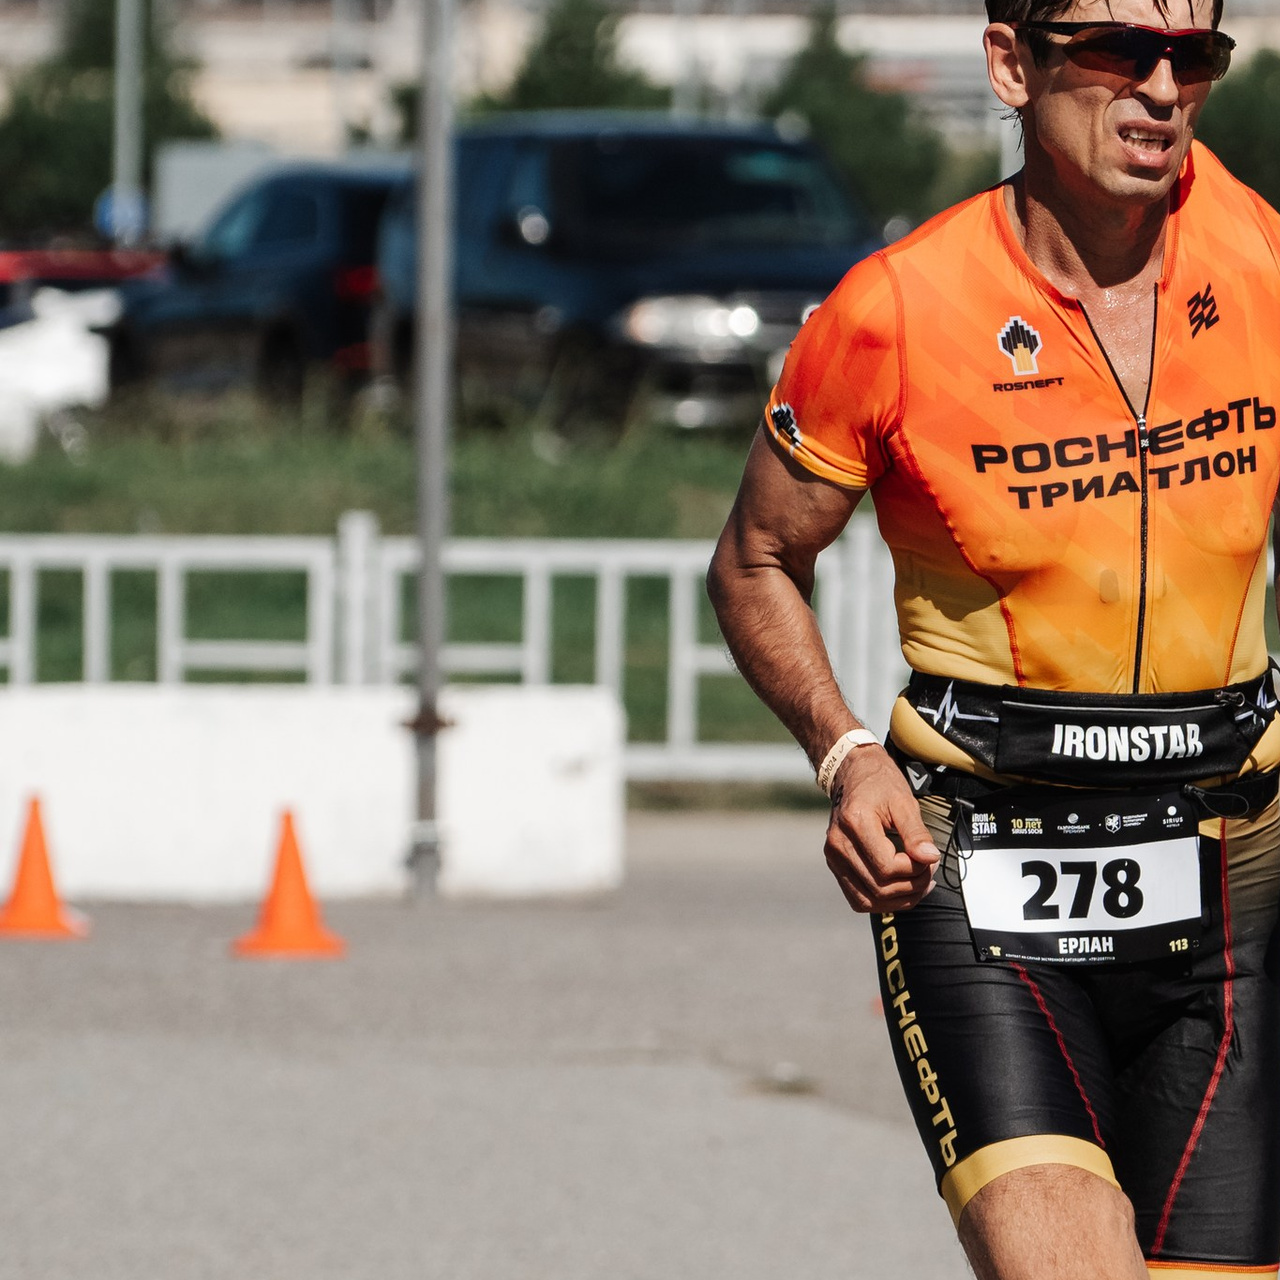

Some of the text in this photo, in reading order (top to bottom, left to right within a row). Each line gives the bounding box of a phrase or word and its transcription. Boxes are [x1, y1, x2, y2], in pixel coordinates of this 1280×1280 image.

[993, 377, 1064, 392] ROSNEFT
[971, 396, 1276, 474] РОСНЕФТЬ
[1008, 445, 1257, 510] ТРИАТЛОН
[1051, 723, 1203, 762] IRONSTAR
[972, 812, 989, 822] IRON
[1011, 818, 1024, 829] 10
[1162, 816, 1183, 825] SIRIUS
[972, 822, 997, 835] STAR
[1020, 857, 1144, 920] 278
[1058, 936, 1114, 954] ЕРЛАН
[1169, 938, 1189, 952] 113
